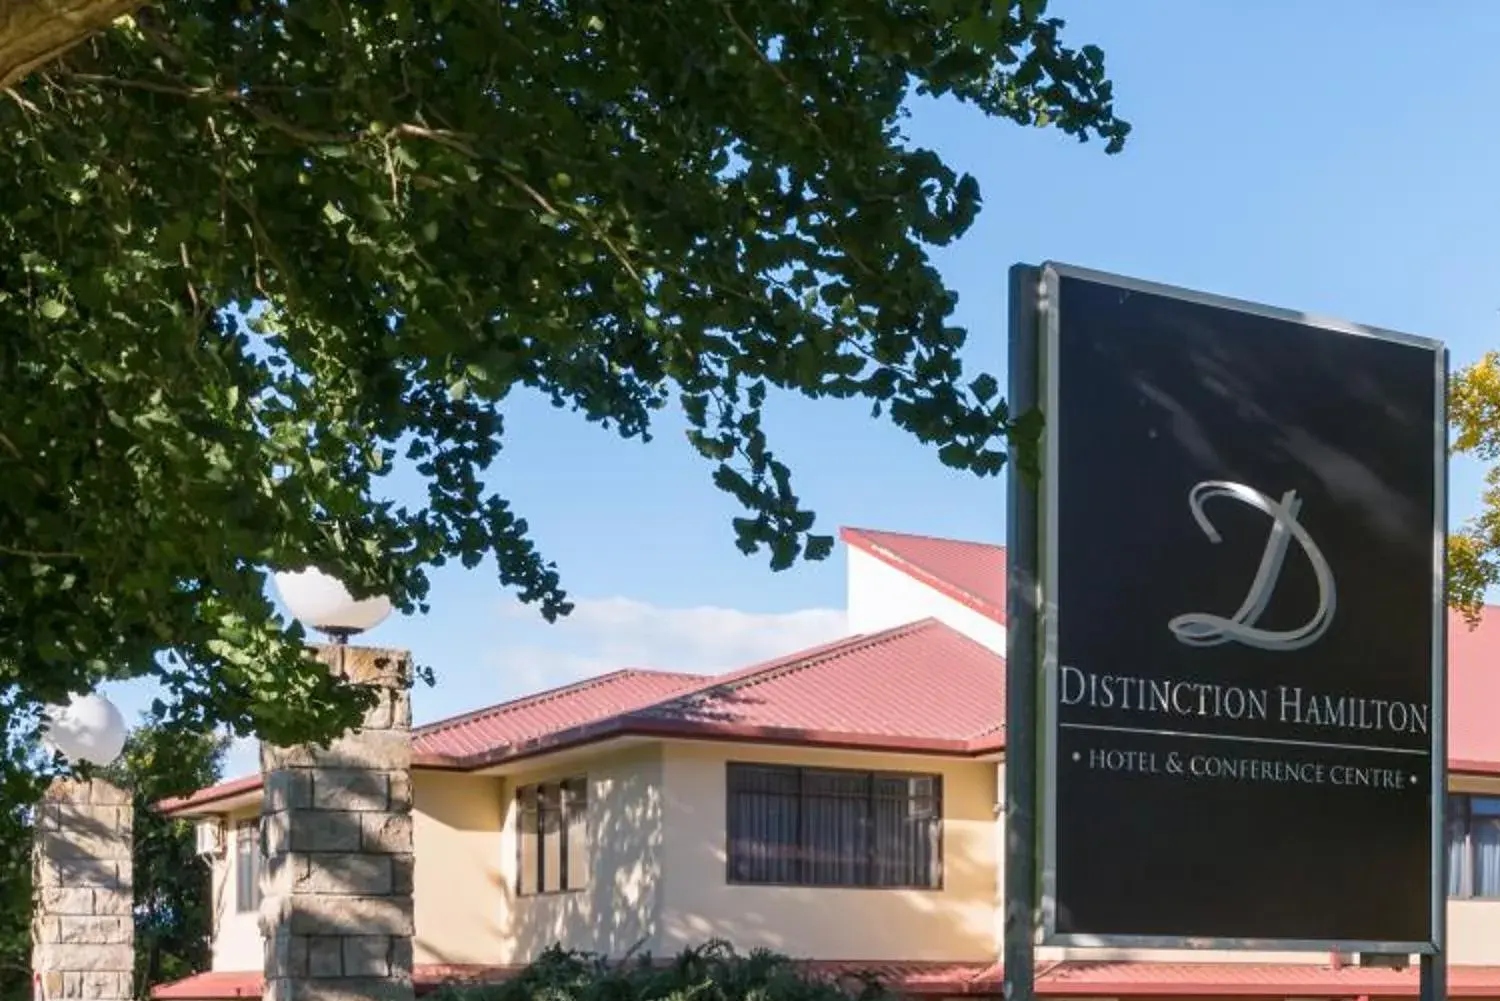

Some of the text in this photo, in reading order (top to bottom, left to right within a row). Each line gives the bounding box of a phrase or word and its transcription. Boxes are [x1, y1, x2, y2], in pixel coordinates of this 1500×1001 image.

[1060, 665, 1428, 735] DISTINCTION HAMILTON
[1089, 749, 1405, 790] HOTEL & CONFERENCE CENTRE
